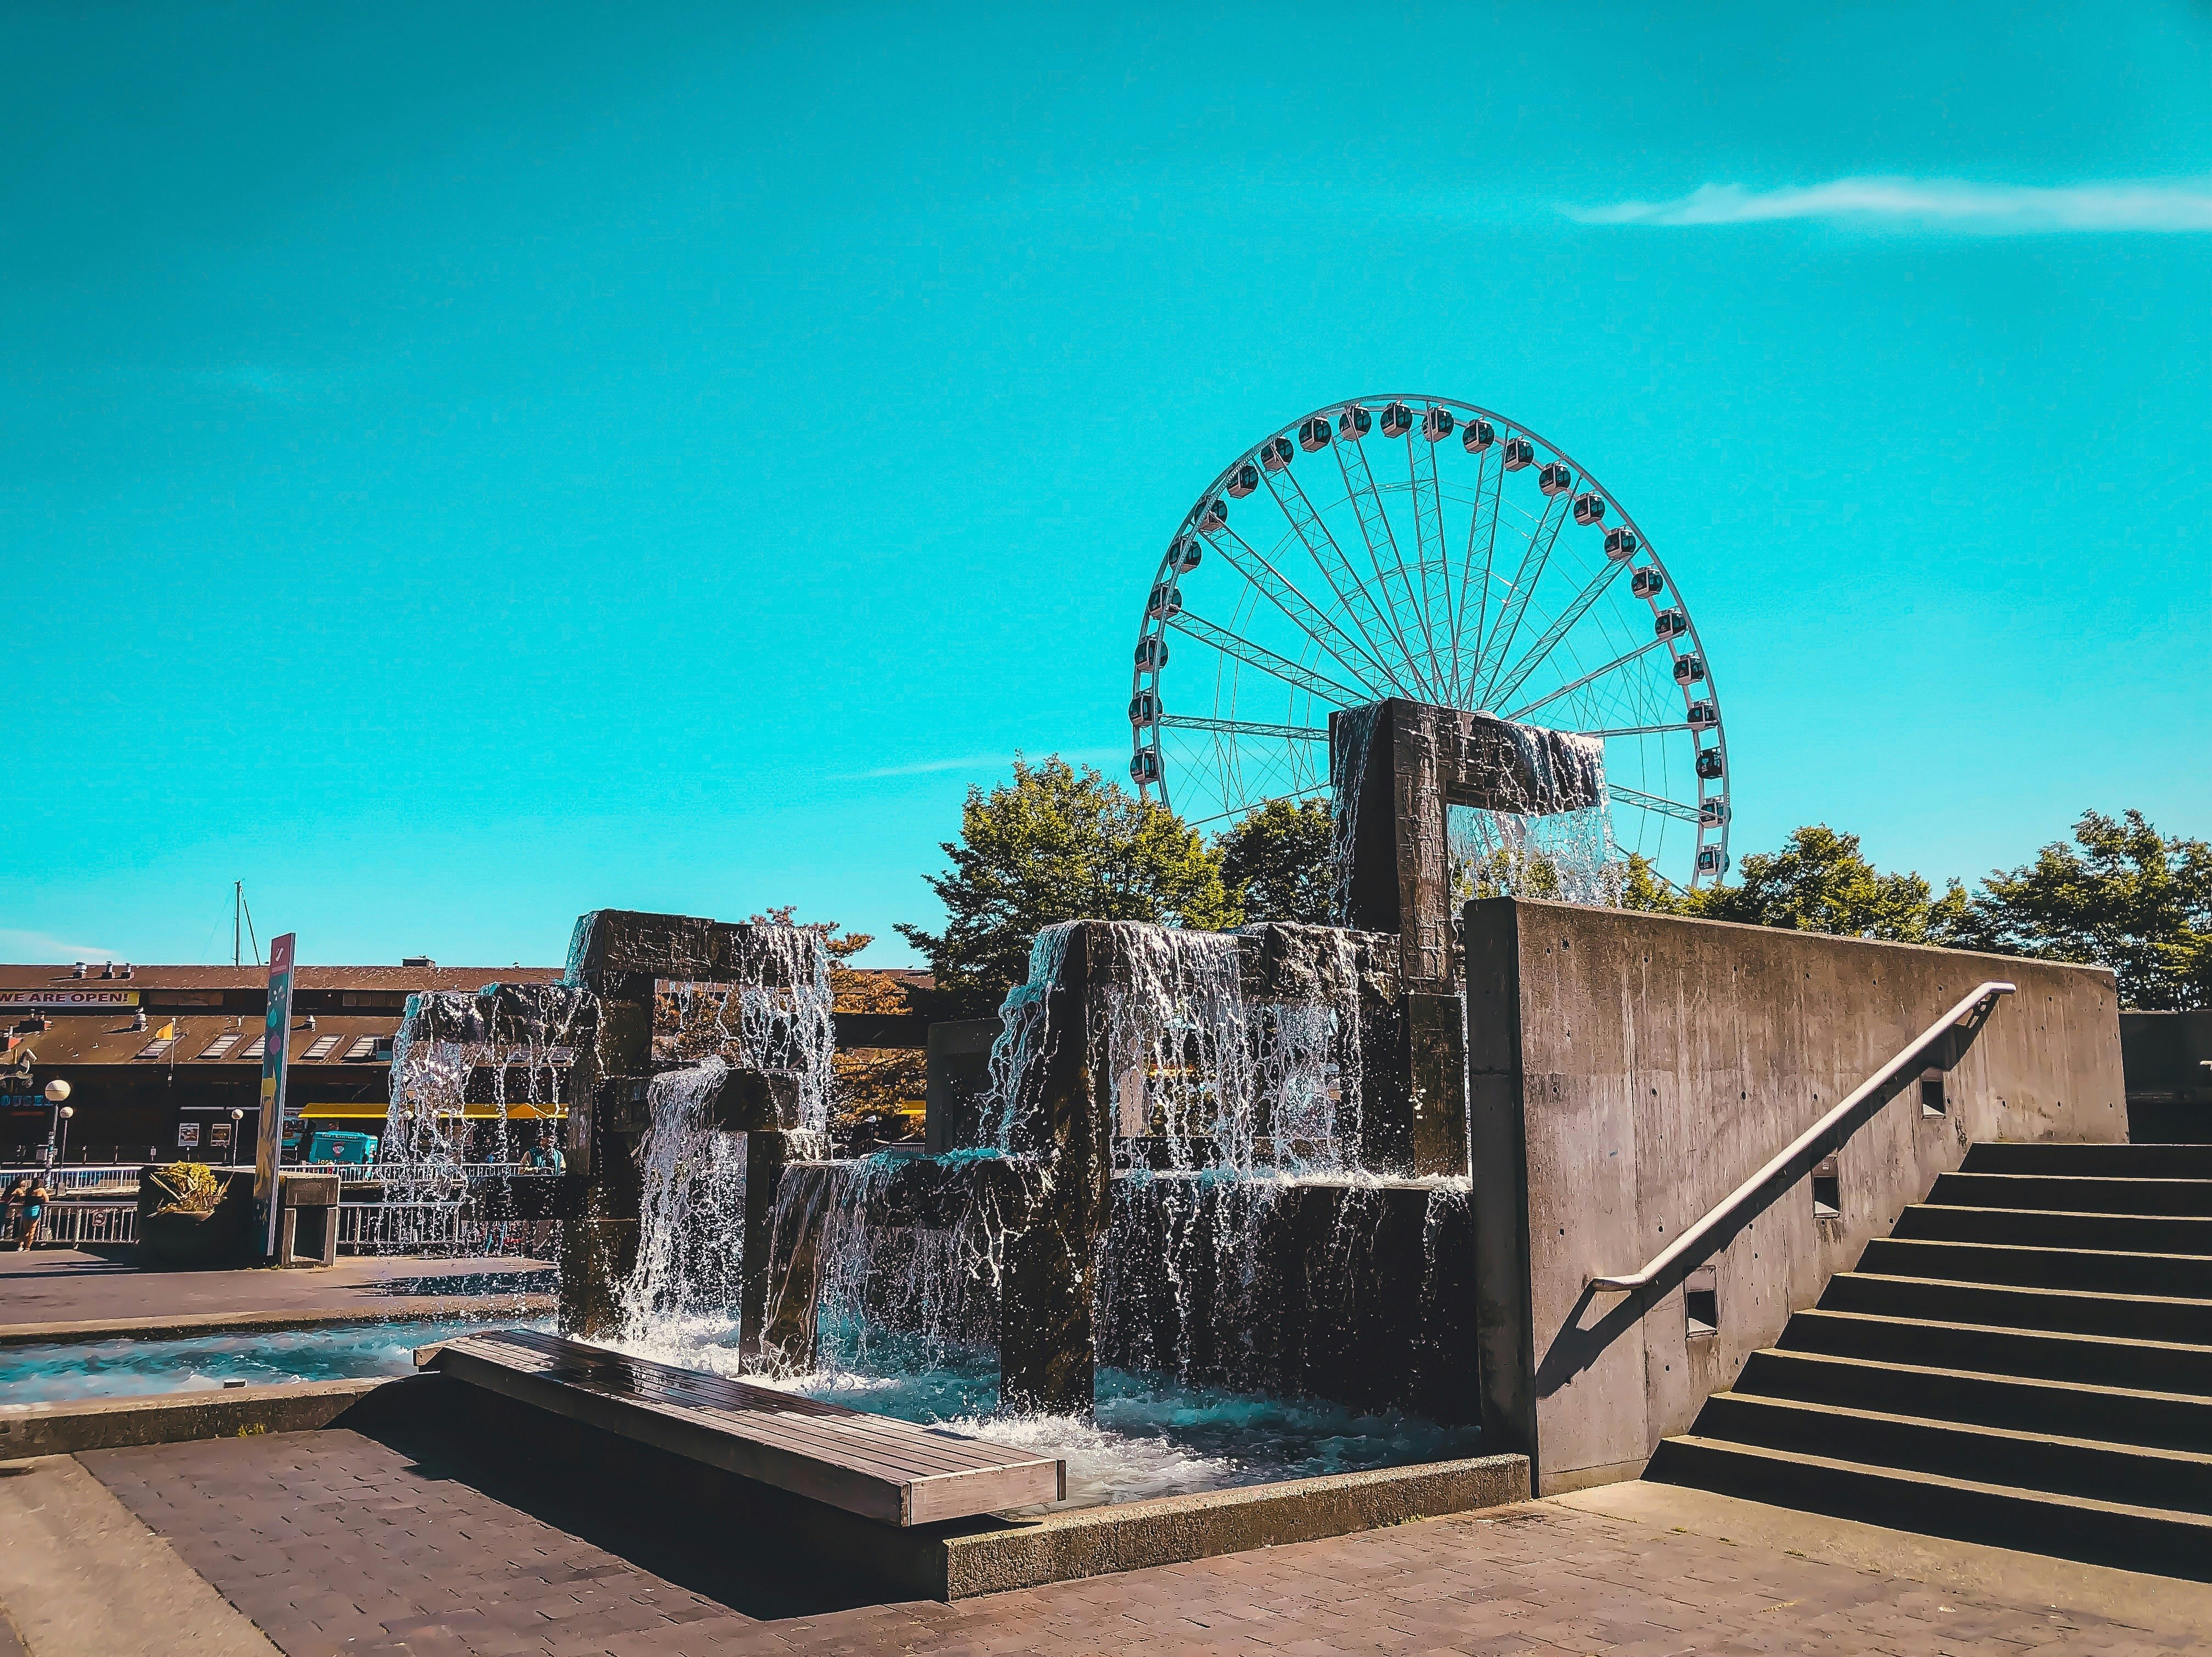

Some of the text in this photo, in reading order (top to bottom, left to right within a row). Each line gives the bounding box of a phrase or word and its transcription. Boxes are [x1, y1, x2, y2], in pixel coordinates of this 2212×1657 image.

[0, 993, 129, 1002] WE ARE OPEN!
